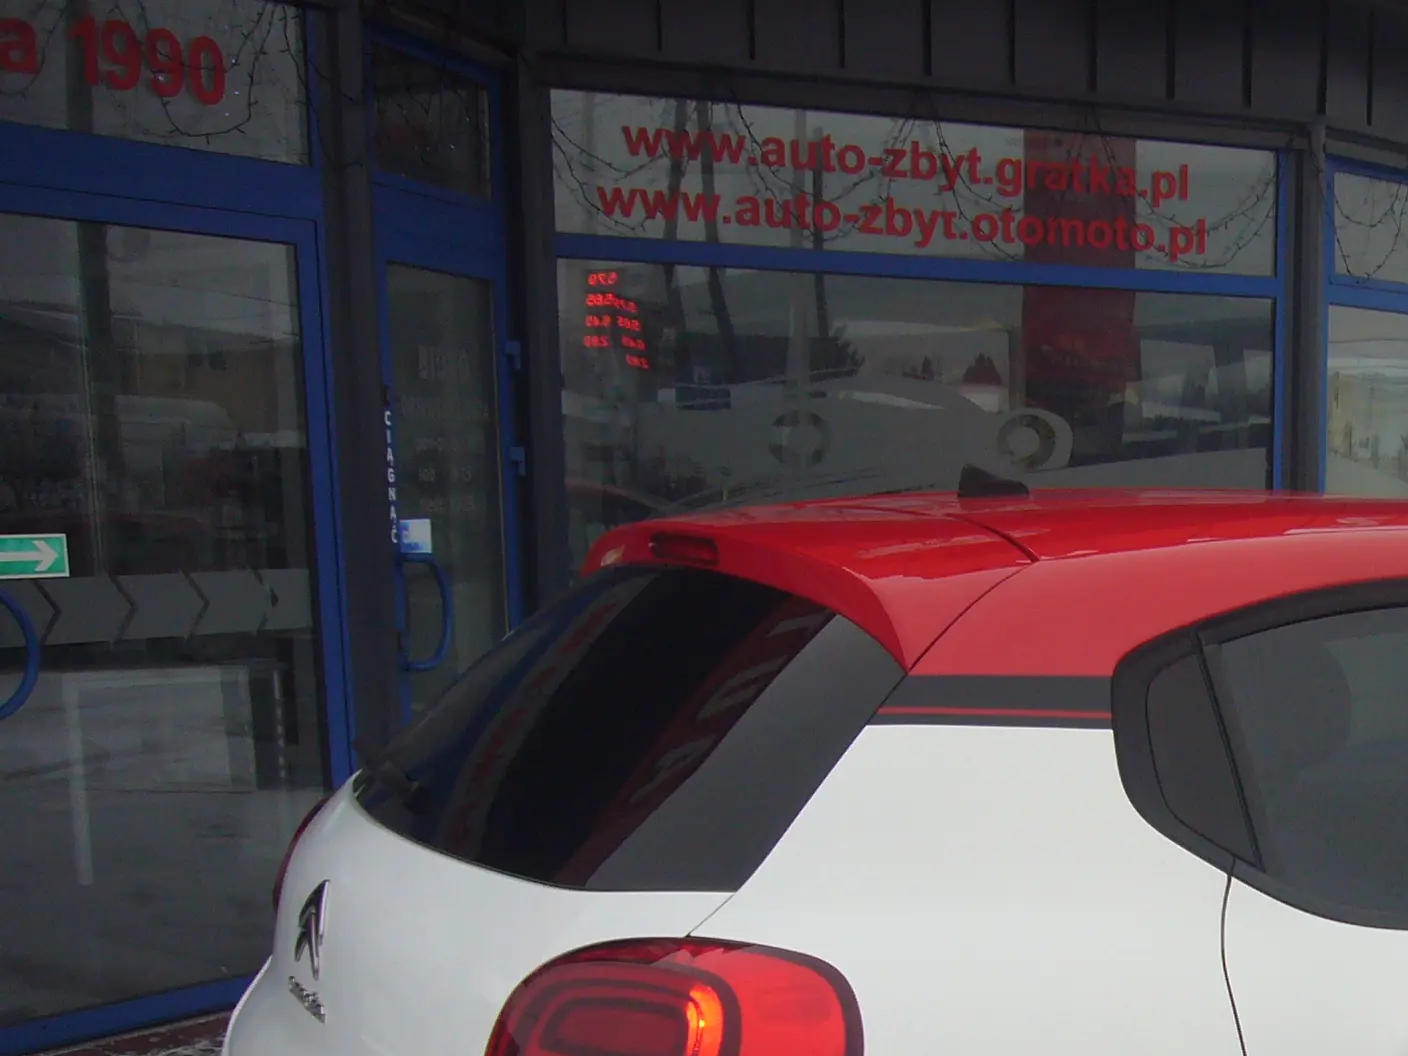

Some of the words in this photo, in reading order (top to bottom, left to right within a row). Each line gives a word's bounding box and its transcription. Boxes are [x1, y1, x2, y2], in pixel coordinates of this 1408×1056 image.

[67, 14, 226, 106] 1990
[621, 125, 1189, 208] www.auto-zbyt.gratka.pl
[596, 185, 1206, 262] www.auto-zbyt.otomoto.pl
